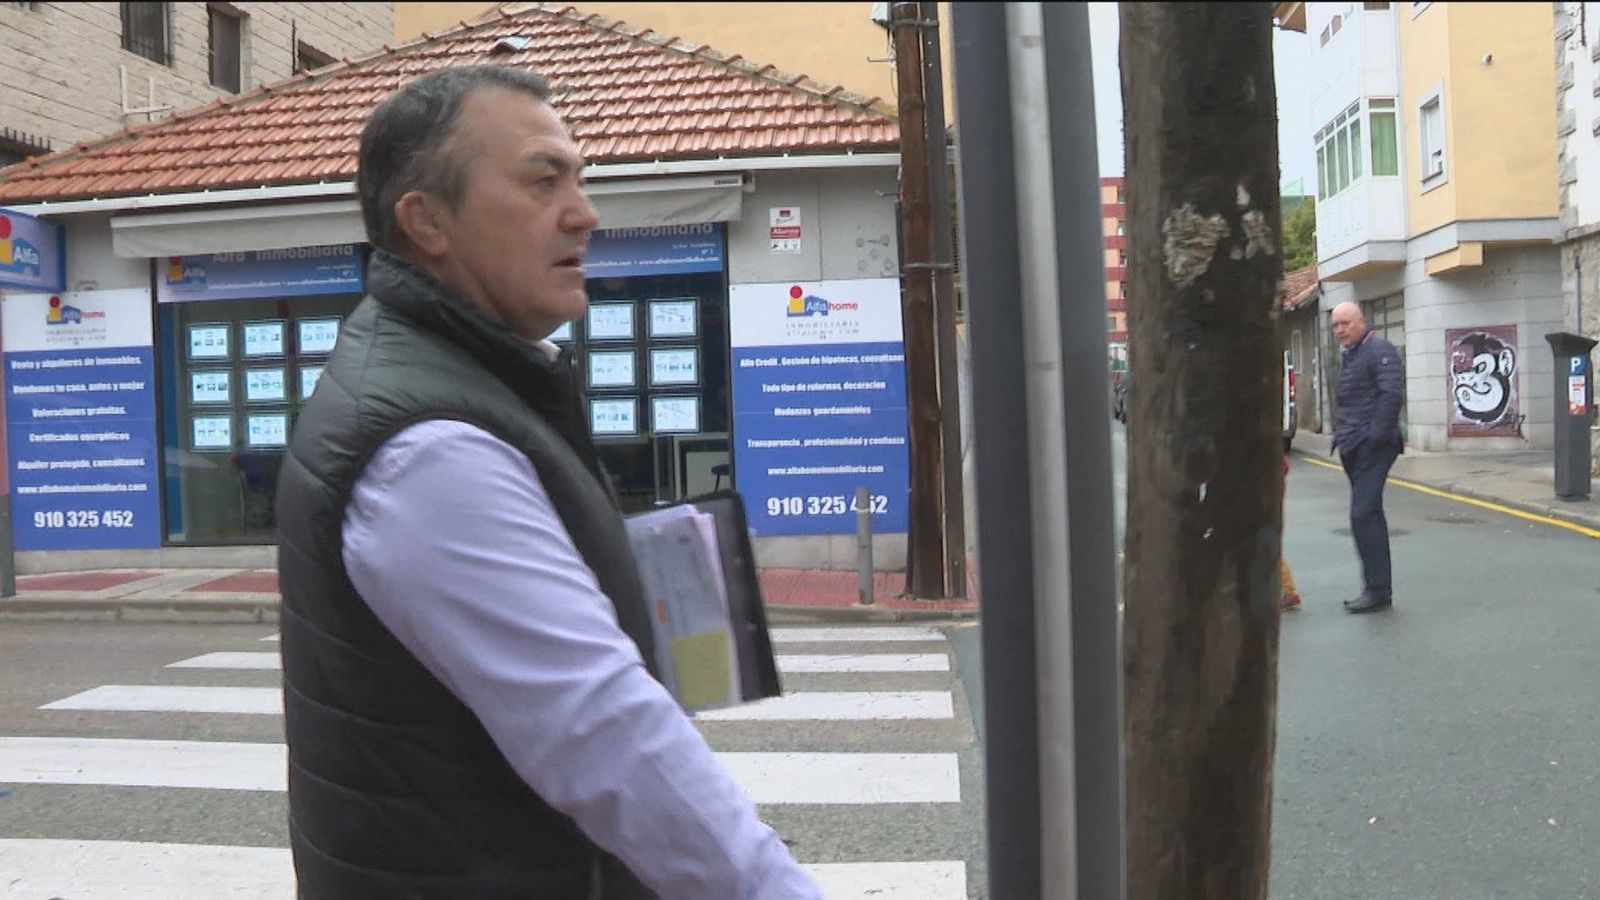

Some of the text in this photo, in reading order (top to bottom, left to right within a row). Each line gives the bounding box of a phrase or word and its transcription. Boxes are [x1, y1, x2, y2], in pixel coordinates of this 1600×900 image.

[811, 357, 820, 366] de
[1571, 357, 1581, 373] P
[762, 383, 780, 393] Todo
[796, 383, 806, 392] de
[863, 437, 868, 446] y
[767, 496, 803, 516] 910
[807, 495, 846, 515] 325
[34, 509, 134, 528] 910 325 452
